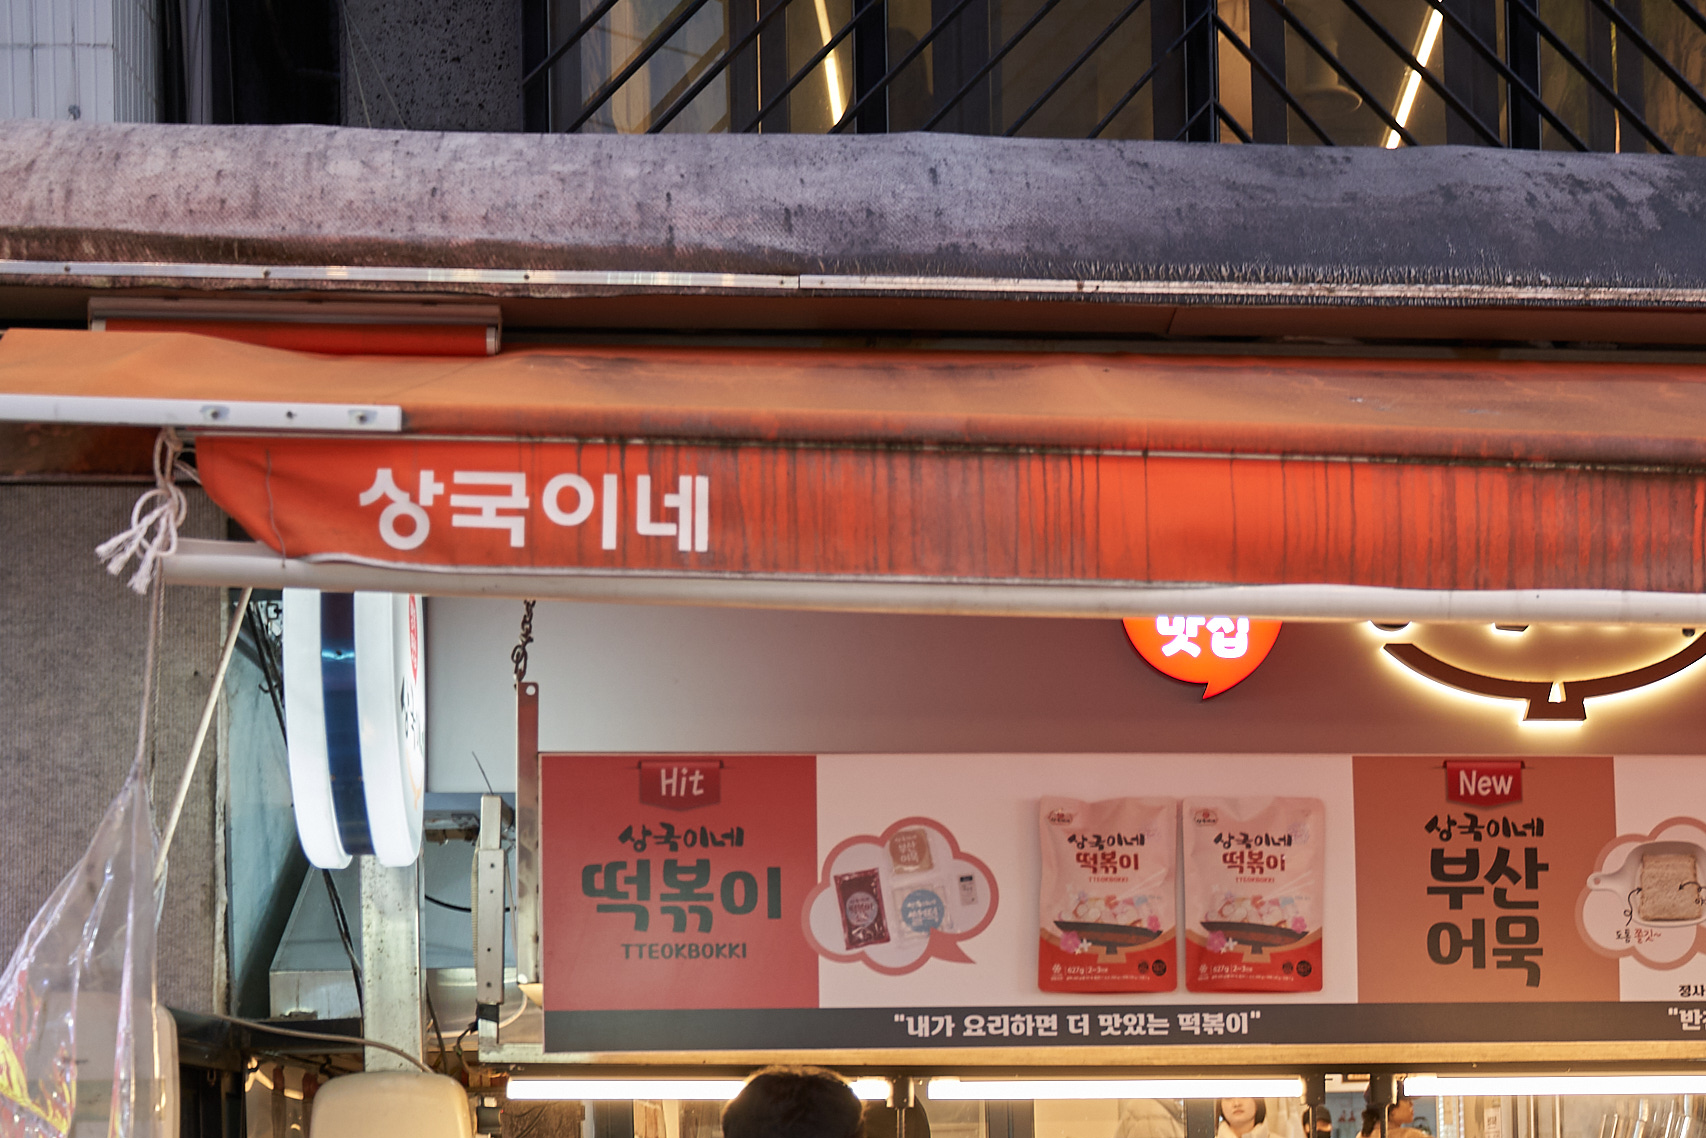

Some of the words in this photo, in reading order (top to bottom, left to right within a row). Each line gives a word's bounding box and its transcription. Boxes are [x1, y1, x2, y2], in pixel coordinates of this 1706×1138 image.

[359, 468, 709, 552] 상국이네
[660, 767, 704, 797] Hit
[1459, 770, 1513, 797] New
[618, 821, 744, 853] 상국이네
[1214, 832, 1292, 849] 상국이네
[1424, 812, 1545, 842] 상국이네
[1068, 833, 1145, 851] 상국이네
[1076, 851, 1139, 874] 떡볶이
[1222, 850, 1285, 874] 떡볶이
[1426, 847, 1549, 910] 부산
[581, 858, 782, 934] 떡볶이
[621, 942, 747, 960] TTEOKBOKKI
[1426, 916, 1544, 988] 어묵
[963, 1014, 1058, 1037] 요리하면
[1067, 1014, 1090, 1037] 더
[1099, 1013, 1170, 1037] 맛있는
